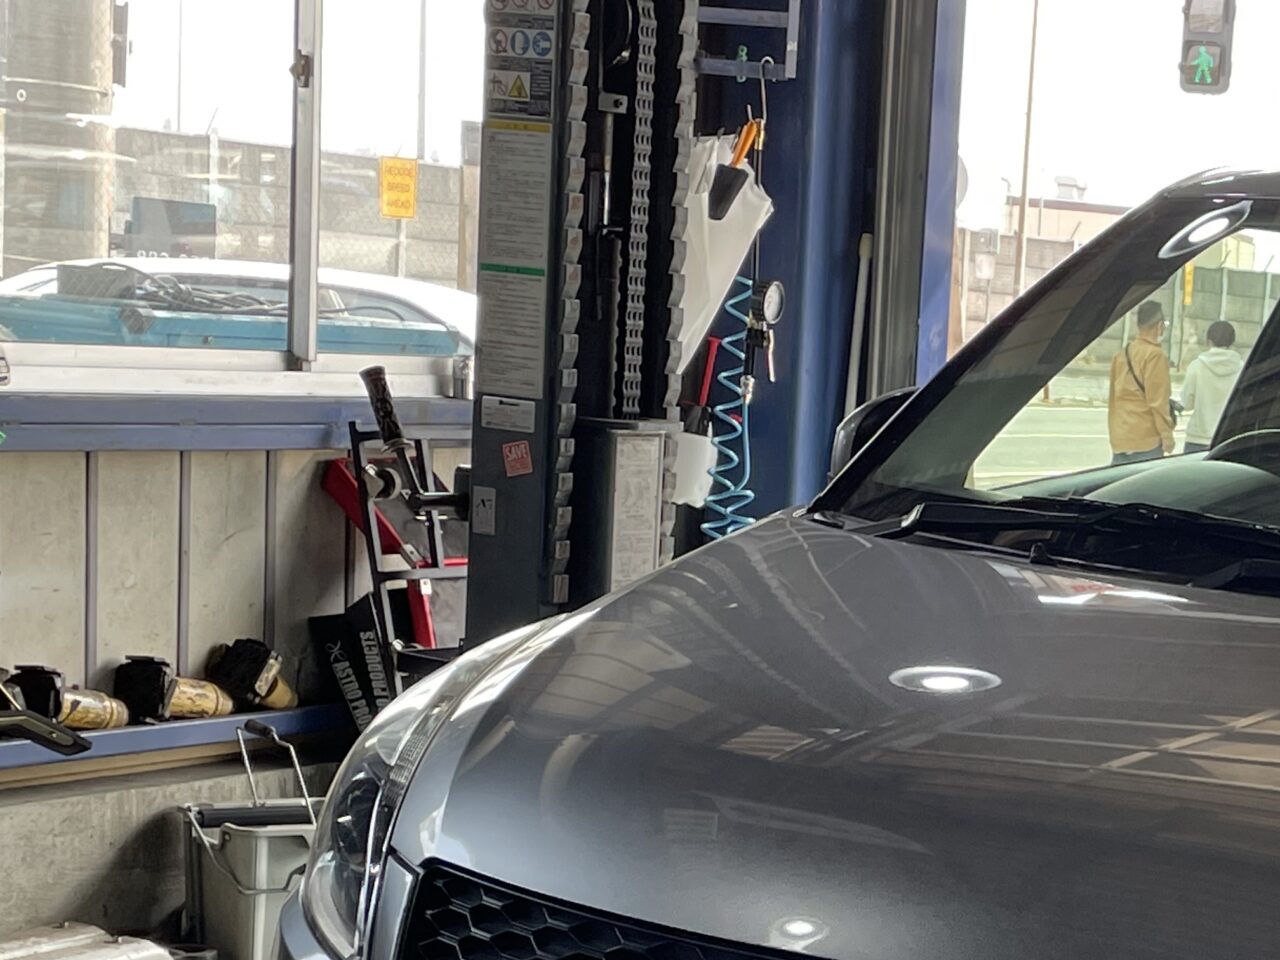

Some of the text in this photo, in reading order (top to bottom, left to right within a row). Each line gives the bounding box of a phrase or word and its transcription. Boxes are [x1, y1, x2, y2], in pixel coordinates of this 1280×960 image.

[505, 443, 528, 461] SAVE
[332, 661, 363, 701] ASTRO
[360, 630, 390, 697] PRODUCTS
